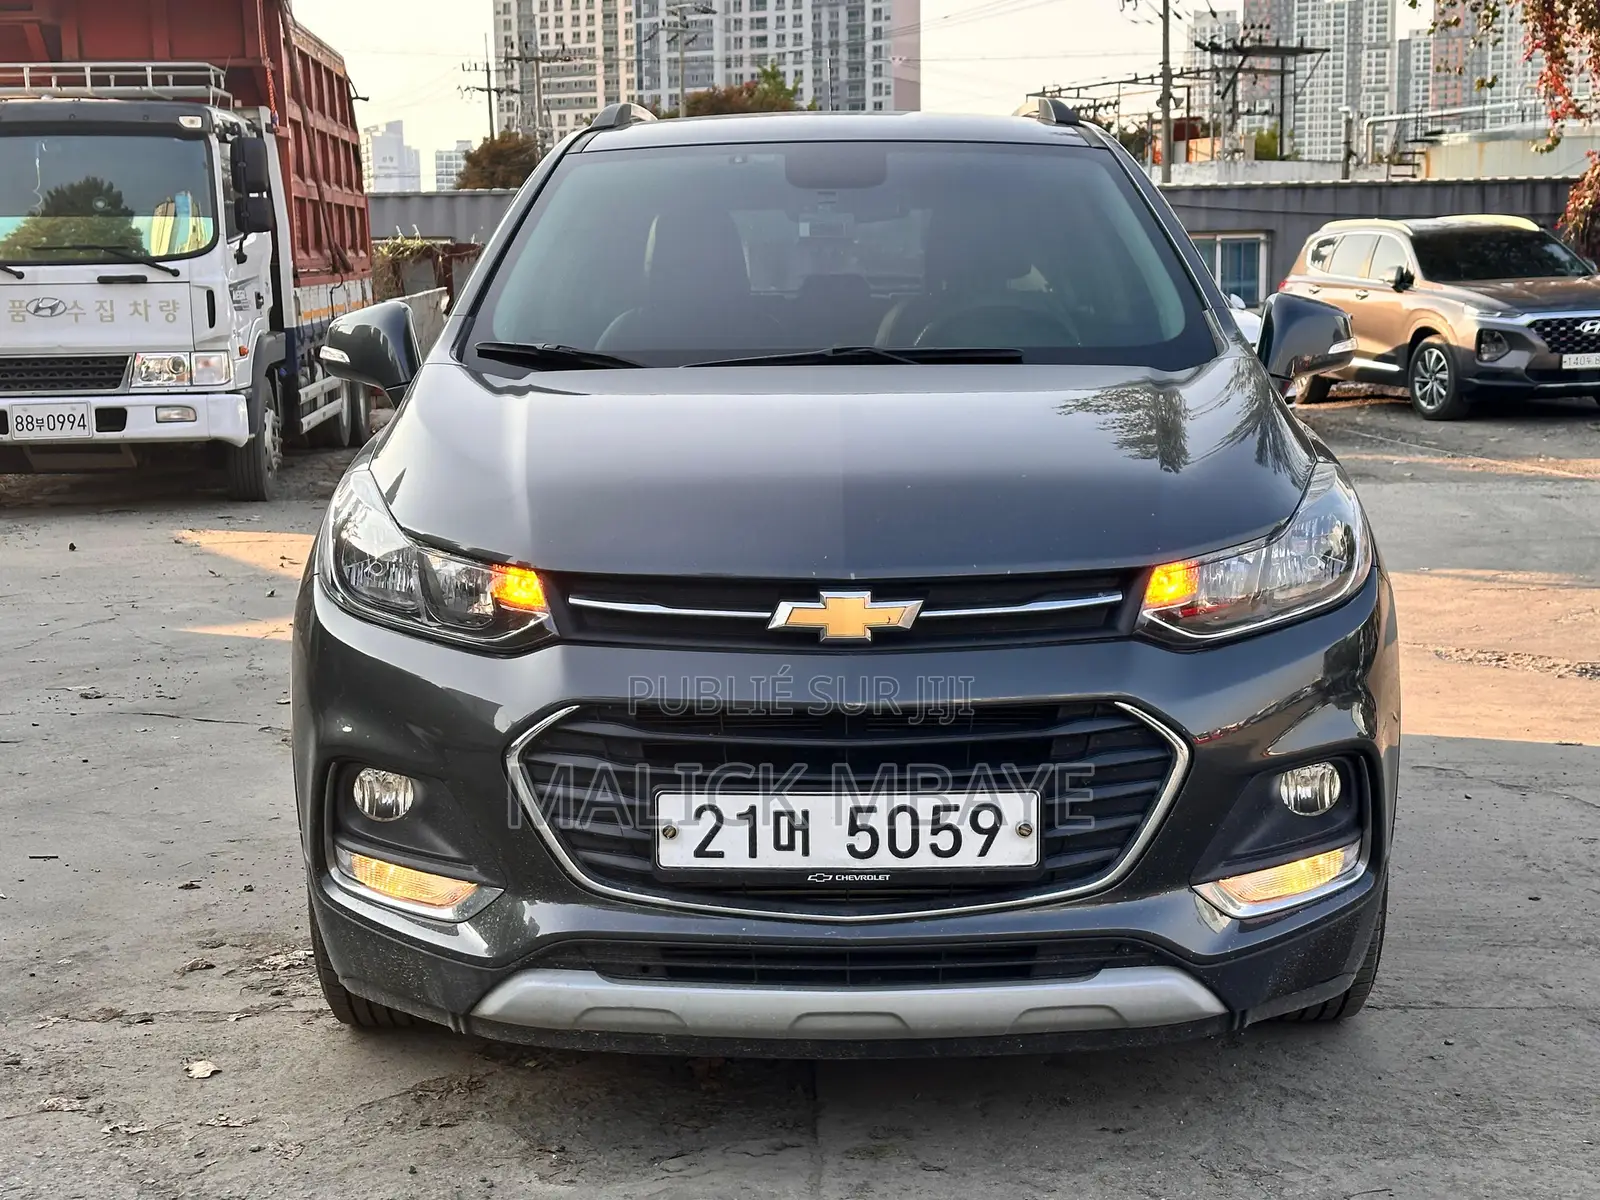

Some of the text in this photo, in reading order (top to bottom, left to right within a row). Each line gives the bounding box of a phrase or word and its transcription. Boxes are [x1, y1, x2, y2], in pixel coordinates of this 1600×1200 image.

[15, 413, 87, 431] 88부0994
[693, 803, 1001, 860] 21머 5059
